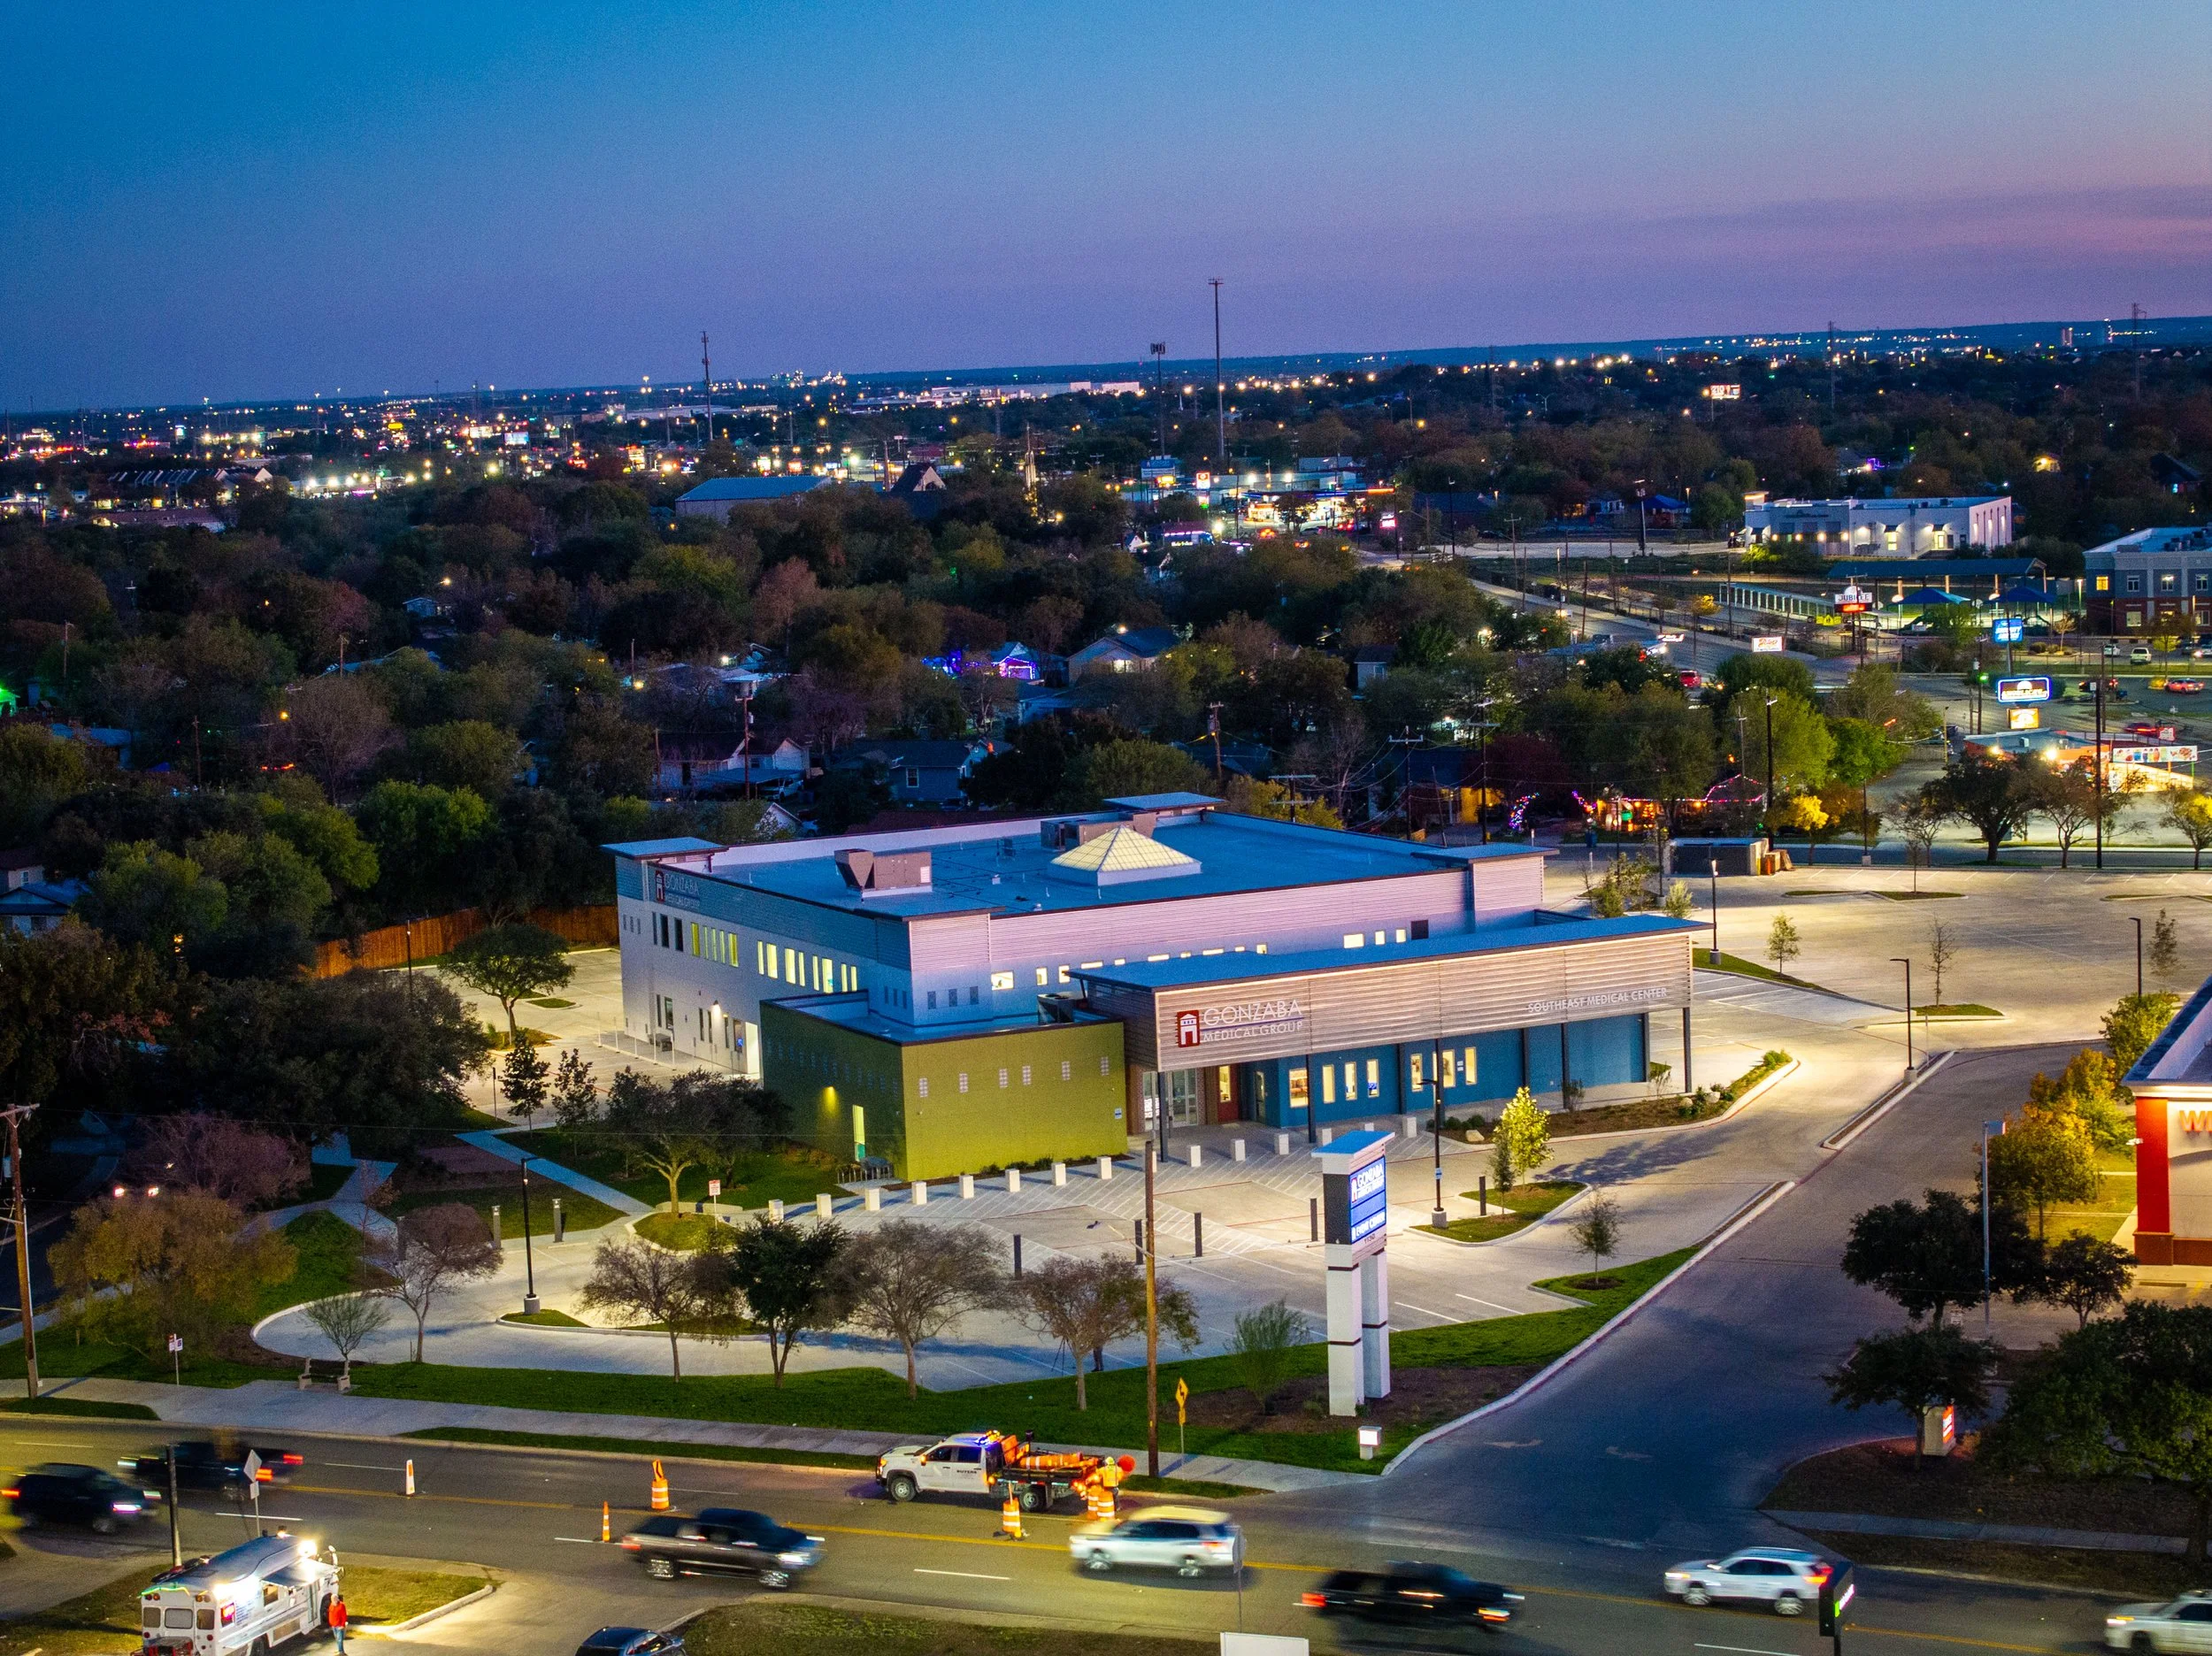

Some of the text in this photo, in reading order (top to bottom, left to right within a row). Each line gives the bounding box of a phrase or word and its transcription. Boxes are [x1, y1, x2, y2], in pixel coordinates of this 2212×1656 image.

[1203, 1000, 1302, 1026] GONZABA
[1528, 987, 1667, 1013] SOUTHEAST MEDICAL CENTER
[1203, 1022, 1303, 1042] MEDICAL GROUP
